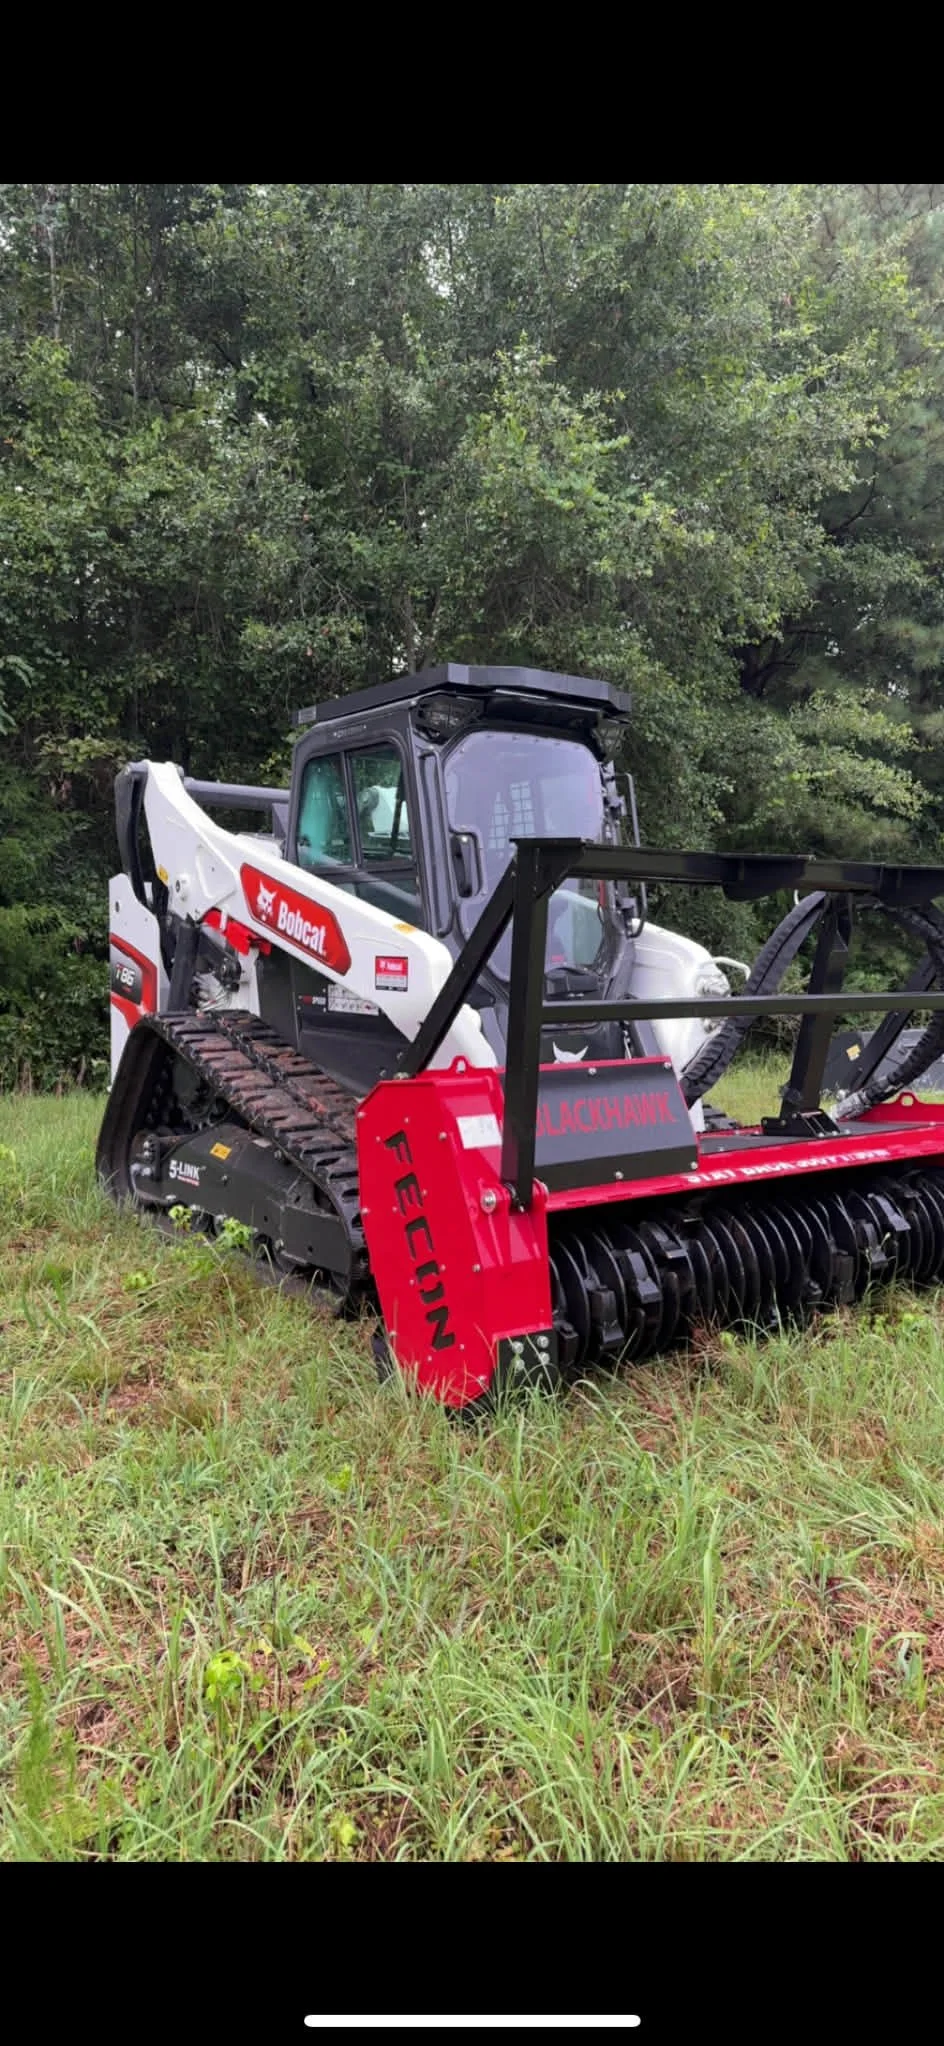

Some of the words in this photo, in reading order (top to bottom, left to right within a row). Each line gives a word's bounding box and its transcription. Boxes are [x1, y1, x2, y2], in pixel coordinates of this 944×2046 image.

[277, 900, 327, 956] Bobcat
[168, 1159, 201, 1181] 5-LINK
[384, 1130, 456, 1351] FECON
